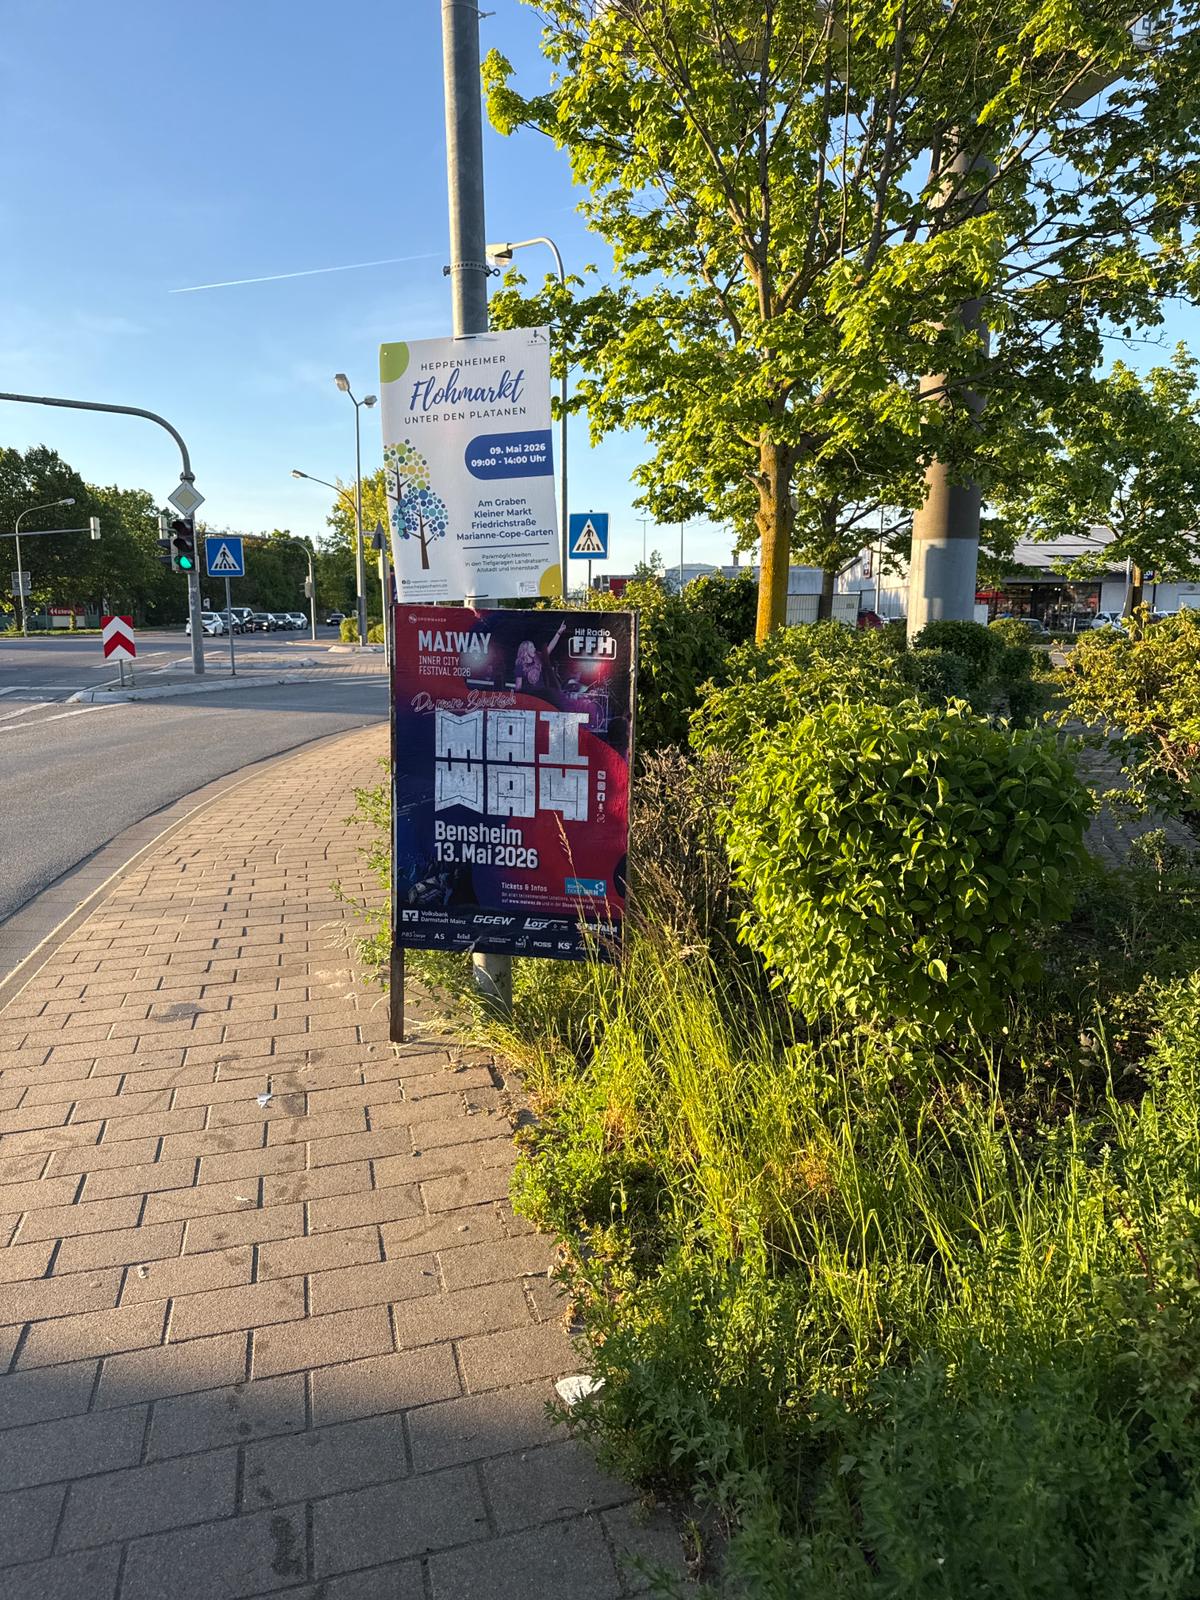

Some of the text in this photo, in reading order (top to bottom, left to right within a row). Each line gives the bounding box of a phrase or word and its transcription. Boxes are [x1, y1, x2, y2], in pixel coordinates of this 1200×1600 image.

[421, 355, 506, 371] HEPPENHEIMER
[410, 368, 525, 411] Flohmarkt
[404, 407, 527, 424] UNTER DEN PLATANEN
[490, 443, 546, 455] 09. Mai 2026
[471, 459, 496, 467] 09:00
[504, 456, 528, 465] 14:00
[530, 455, 547, 463] Uhr
[478, 498, 527, 508] Am Graben
[474, 508, 532, 518] Kleiner Markt
[471, 518, 537, 529] Friedrichstraße
[456, 528, 554, 541] Marianne-Cope-Garten
[574, 628, 611, 637] Hit Radio
[418, 630, 492, 653] MAIWAY
[573, 637, 613, 655] FFH
[419, 655, 460, 666] INNER CITY
[419, 666, 471, 677] FESTIVAL 2026
[435, 820, 522, 846] Bensheim
[434, 842, 539, 869] 13. Mai 2026
[501, 882, 523, 890] Tickets
[473, 915, 516, 925] GGEW
